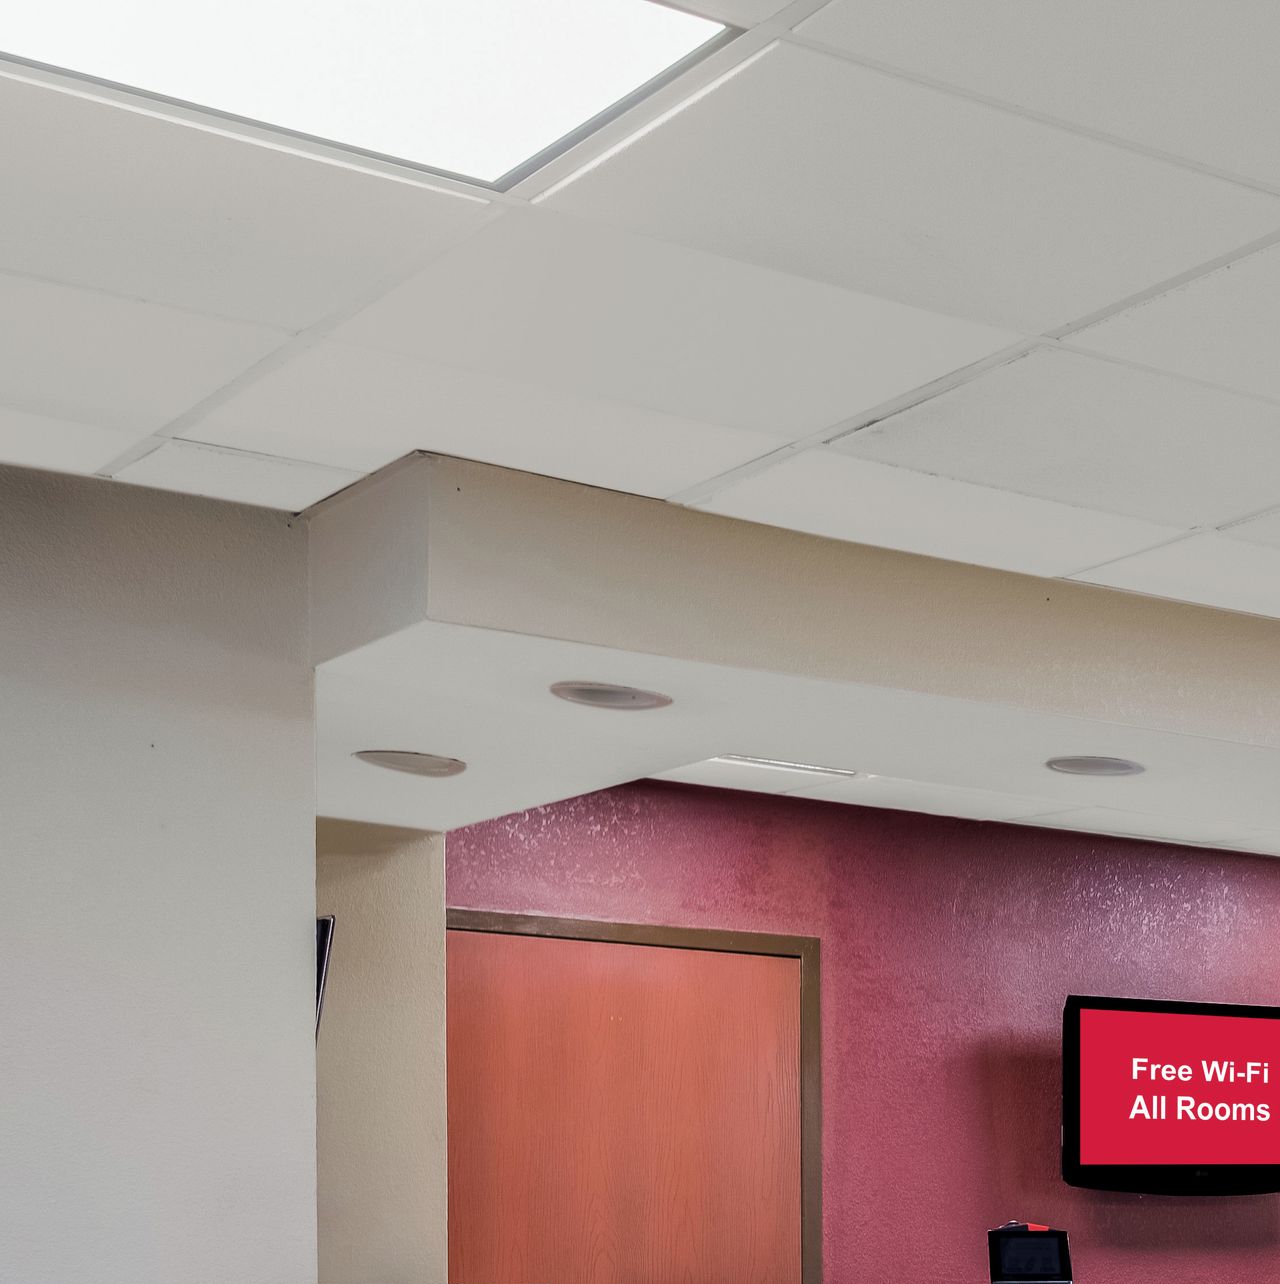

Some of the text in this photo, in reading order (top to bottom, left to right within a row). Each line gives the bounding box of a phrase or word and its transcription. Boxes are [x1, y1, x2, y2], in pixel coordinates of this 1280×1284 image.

[1132, 1057, 1269, 1083] Free Wi-Fi
[1129, 1095, 1271, 1121] All Rooms
